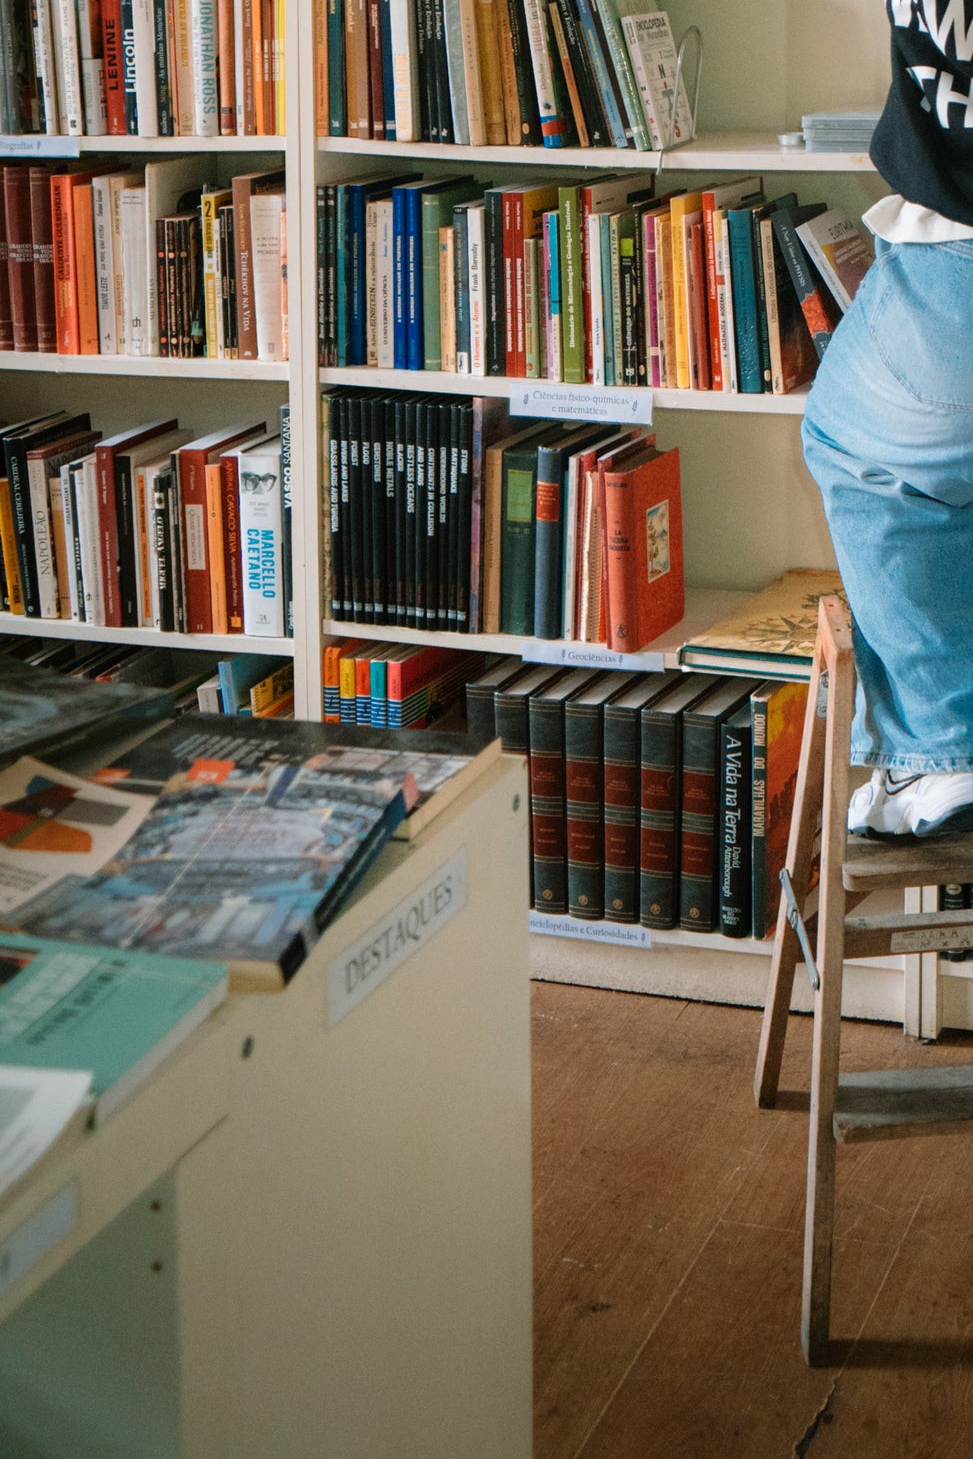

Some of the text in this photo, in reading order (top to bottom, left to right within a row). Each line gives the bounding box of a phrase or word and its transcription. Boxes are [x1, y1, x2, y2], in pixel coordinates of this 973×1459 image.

[104, 19, 119, 91] LENINE
[122, 28, 136, 93] Lincoln
[199, 1, 215, 114] JONATHAN ROSS
[205, 201, 212, 218] 2
[471, 243, 479, 292] Frank Barnaby
[533, 390, 568, 401] Ciências
[558, 405, 608, 416] matemáticas
[282, 416, 292, 509] VASCO SANTANA
[386, 441, 394, 498] NOBLE METALS
[10, 455, 25, 535] CARDEAL CEREJEIRA
[428, 492, 434, 500] IN
[35, 509, 52, 575] NAPOLEÃO
[246, 528, 261, 590] CAETANO
[260, 528, 276, 598] MARCELLO
[568, 651, 617, 663] Geociências
[725, 734, 742, 845] A Vida na Terra
[753, 713, 766, 837] MARAVILHAS DO MUNDO
[722, 844, 734, 897] Attenborough
[732, 846, 741, 869] David
[343, 875, 455, 996] DESTAQUES
[528, 919, 579, 934] nciclopédias
[586, 926, 638, 941] Curiosidades
